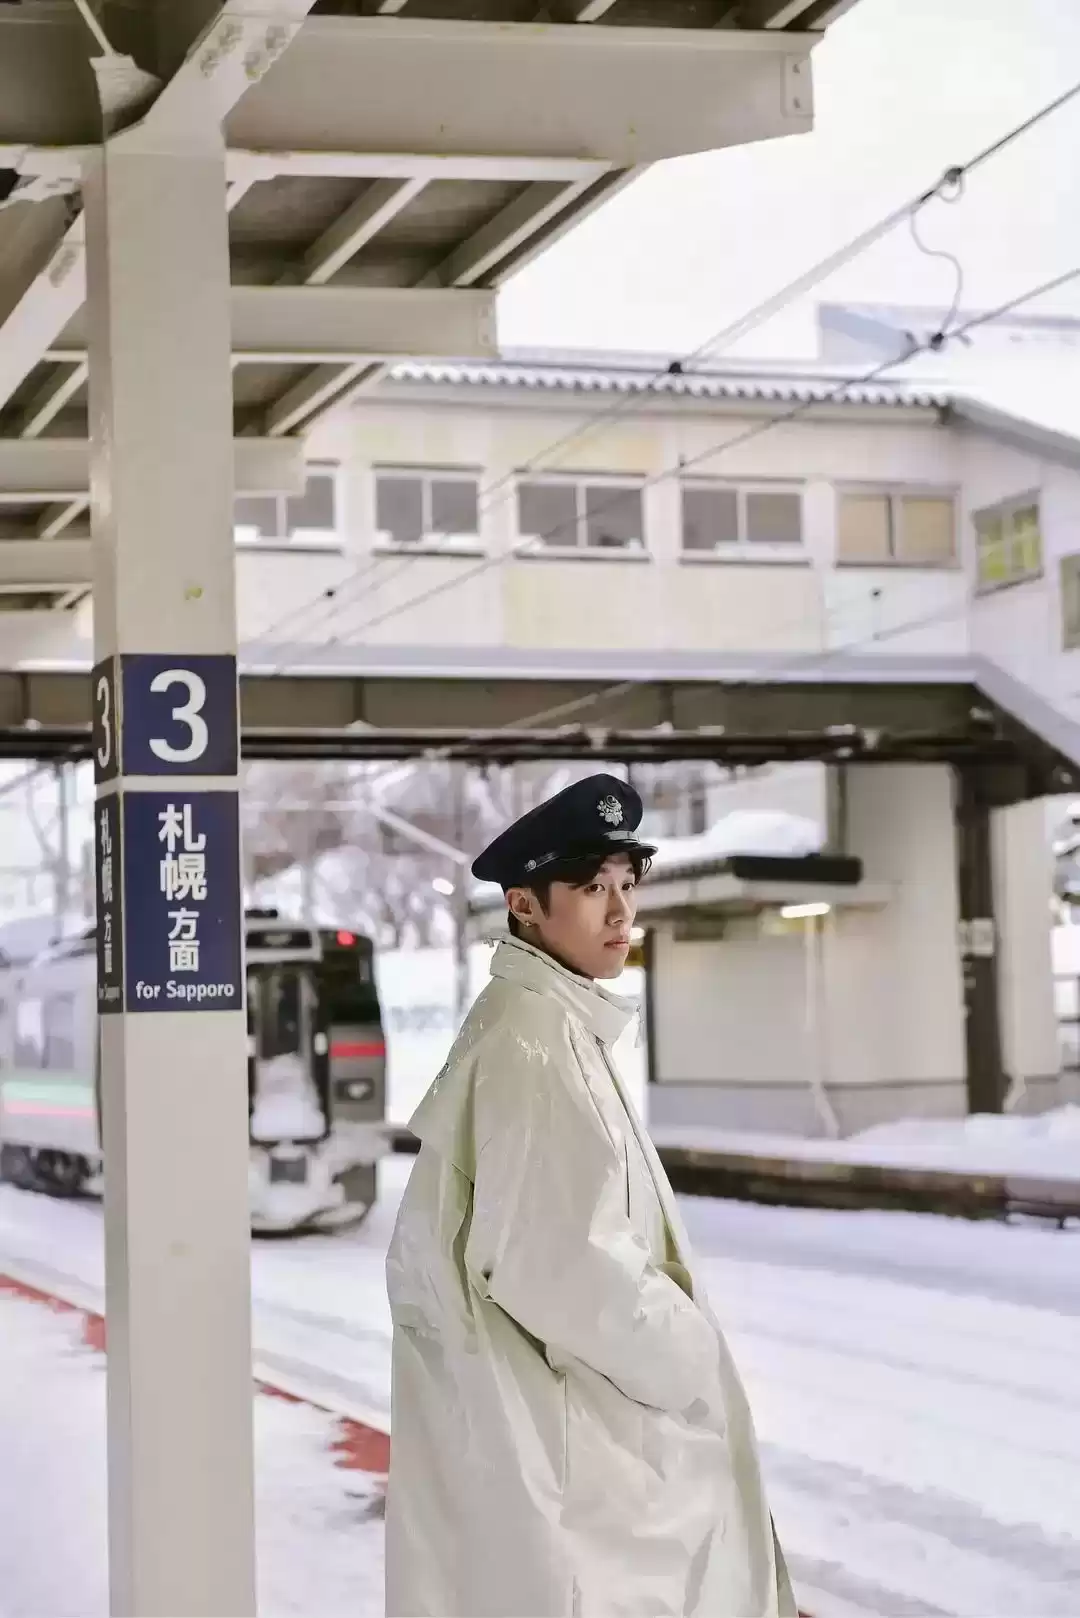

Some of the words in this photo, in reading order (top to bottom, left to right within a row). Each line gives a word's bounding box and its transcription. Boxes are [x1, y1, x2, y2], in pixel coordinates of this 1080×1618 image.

[97, 676, 110, 768] 3
[149, 669, 208, 763] 3
[158, 804, 207, 972] 札幌方面
[136, 981, 161, 999] for
[166, 980, 235, 1002] Sapporo
